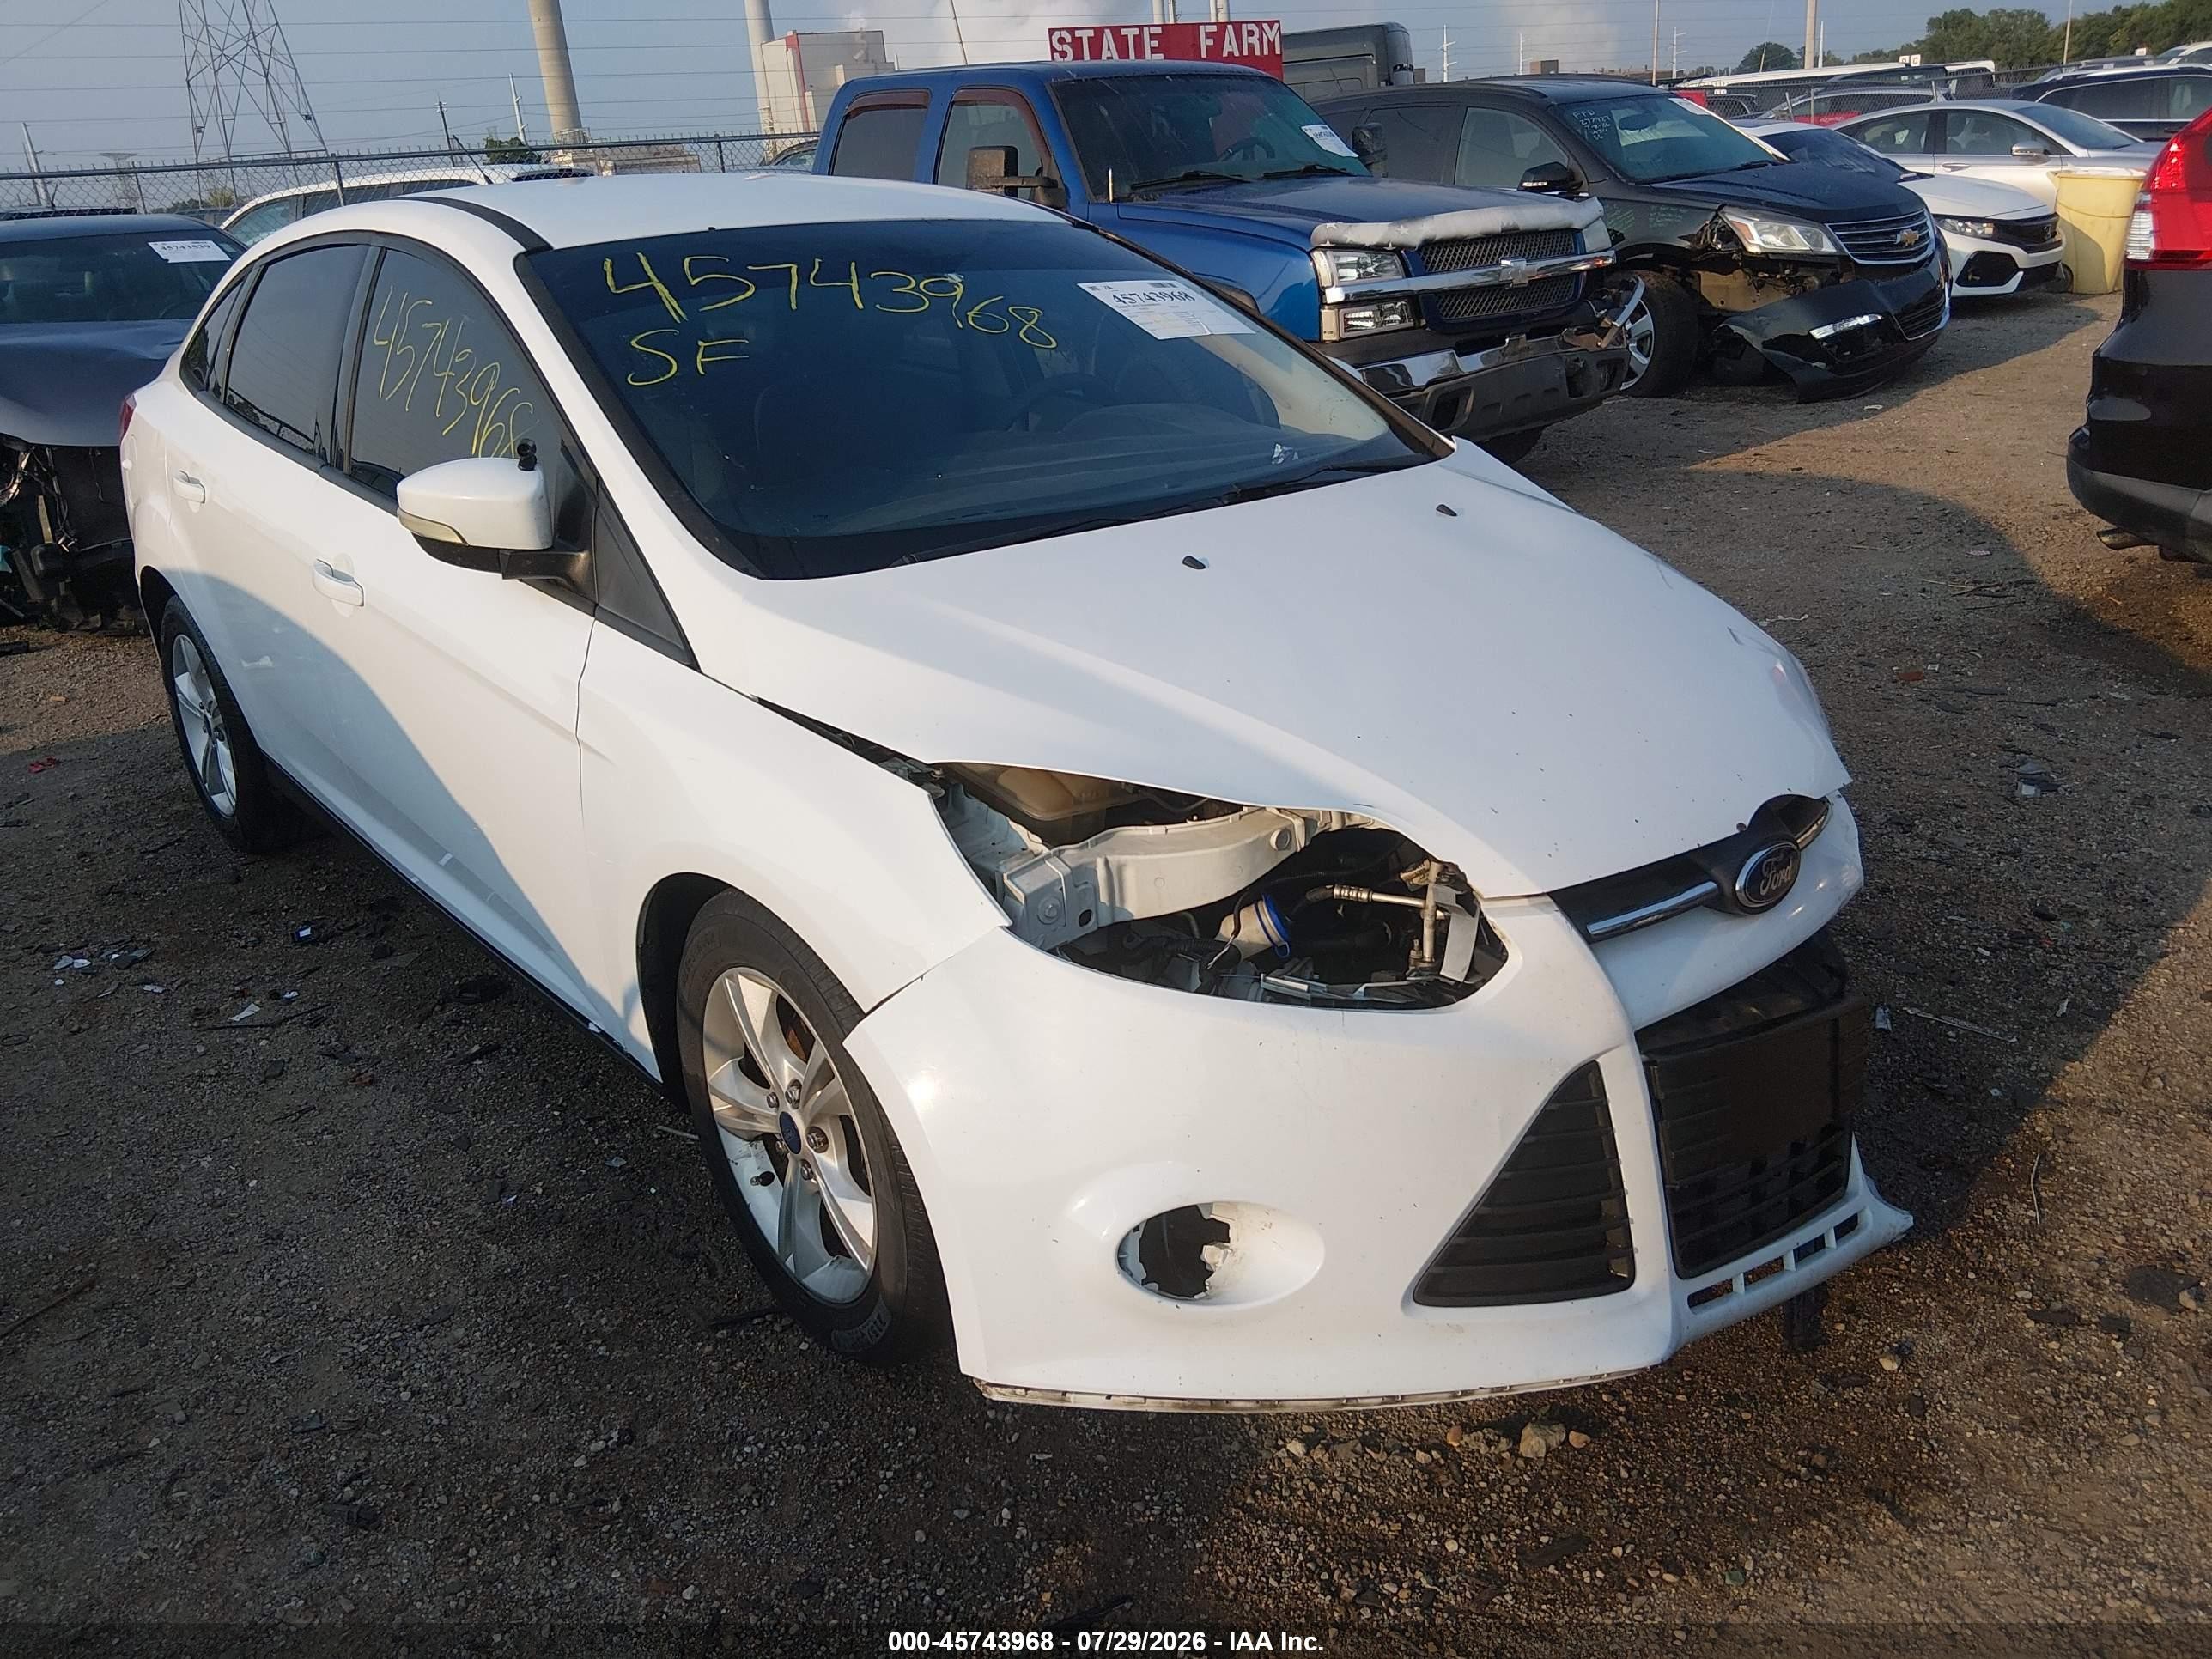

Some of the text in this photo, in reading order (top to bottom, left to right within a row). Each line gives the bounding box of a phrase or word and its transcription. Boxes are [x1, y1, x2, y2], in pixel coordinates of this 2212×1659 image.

[1052, 22, 1281, 62] STATE FARM
[603, 252, 1059, 349] 45743968
[1112, 291, 1196, 305] 45743968
[626, 329, 750, 386] SF
[1759, 852, 1793, 896] Ford
